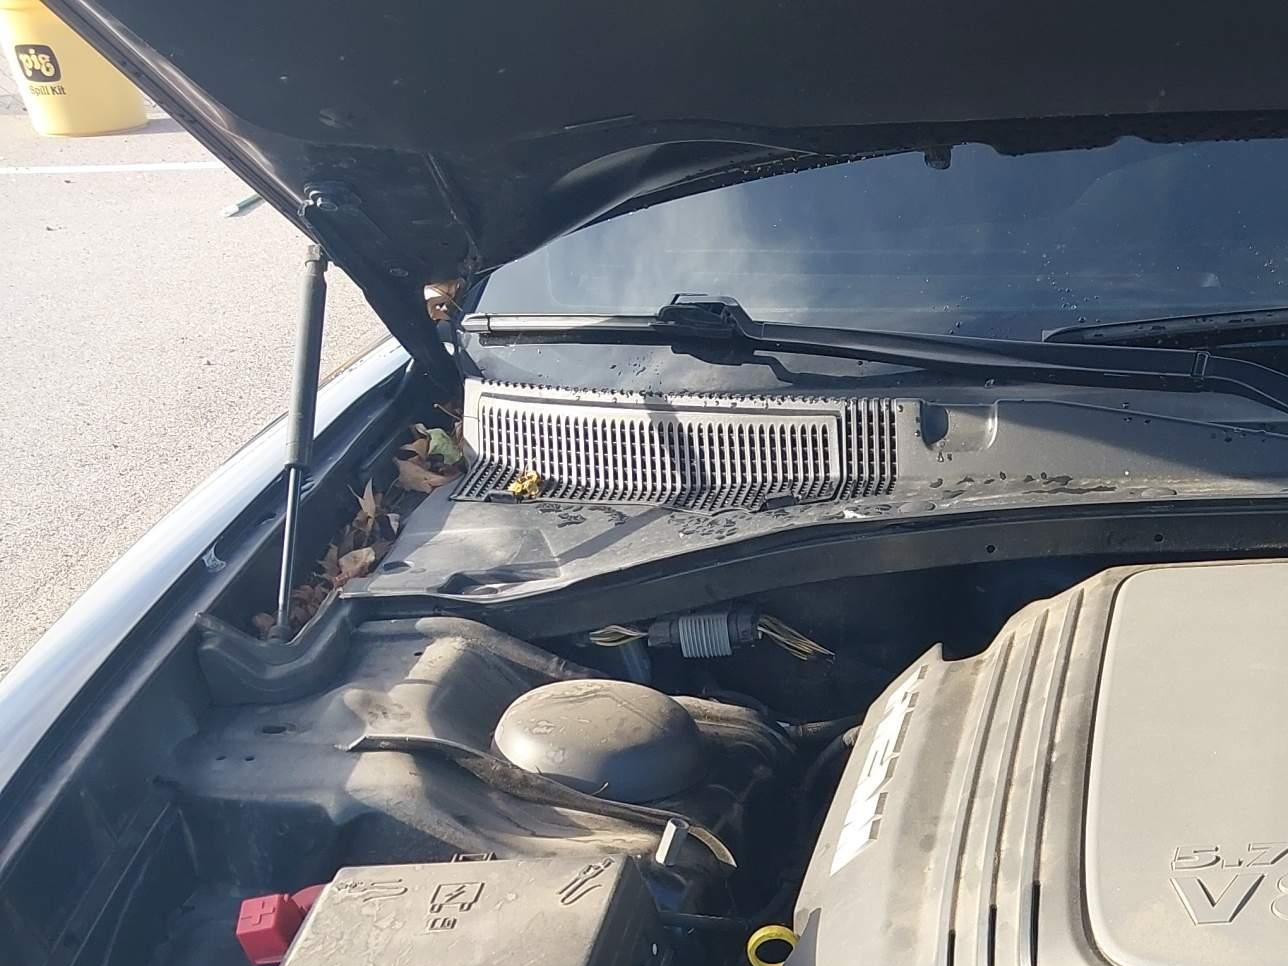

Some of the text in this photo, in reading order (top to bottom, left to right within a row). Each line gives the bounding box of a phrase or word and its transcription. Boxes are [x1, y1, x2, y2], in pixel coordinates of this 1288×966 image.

[19, 48, 55, 77] pig
[30, 85, 66, 97] Spill Kit
